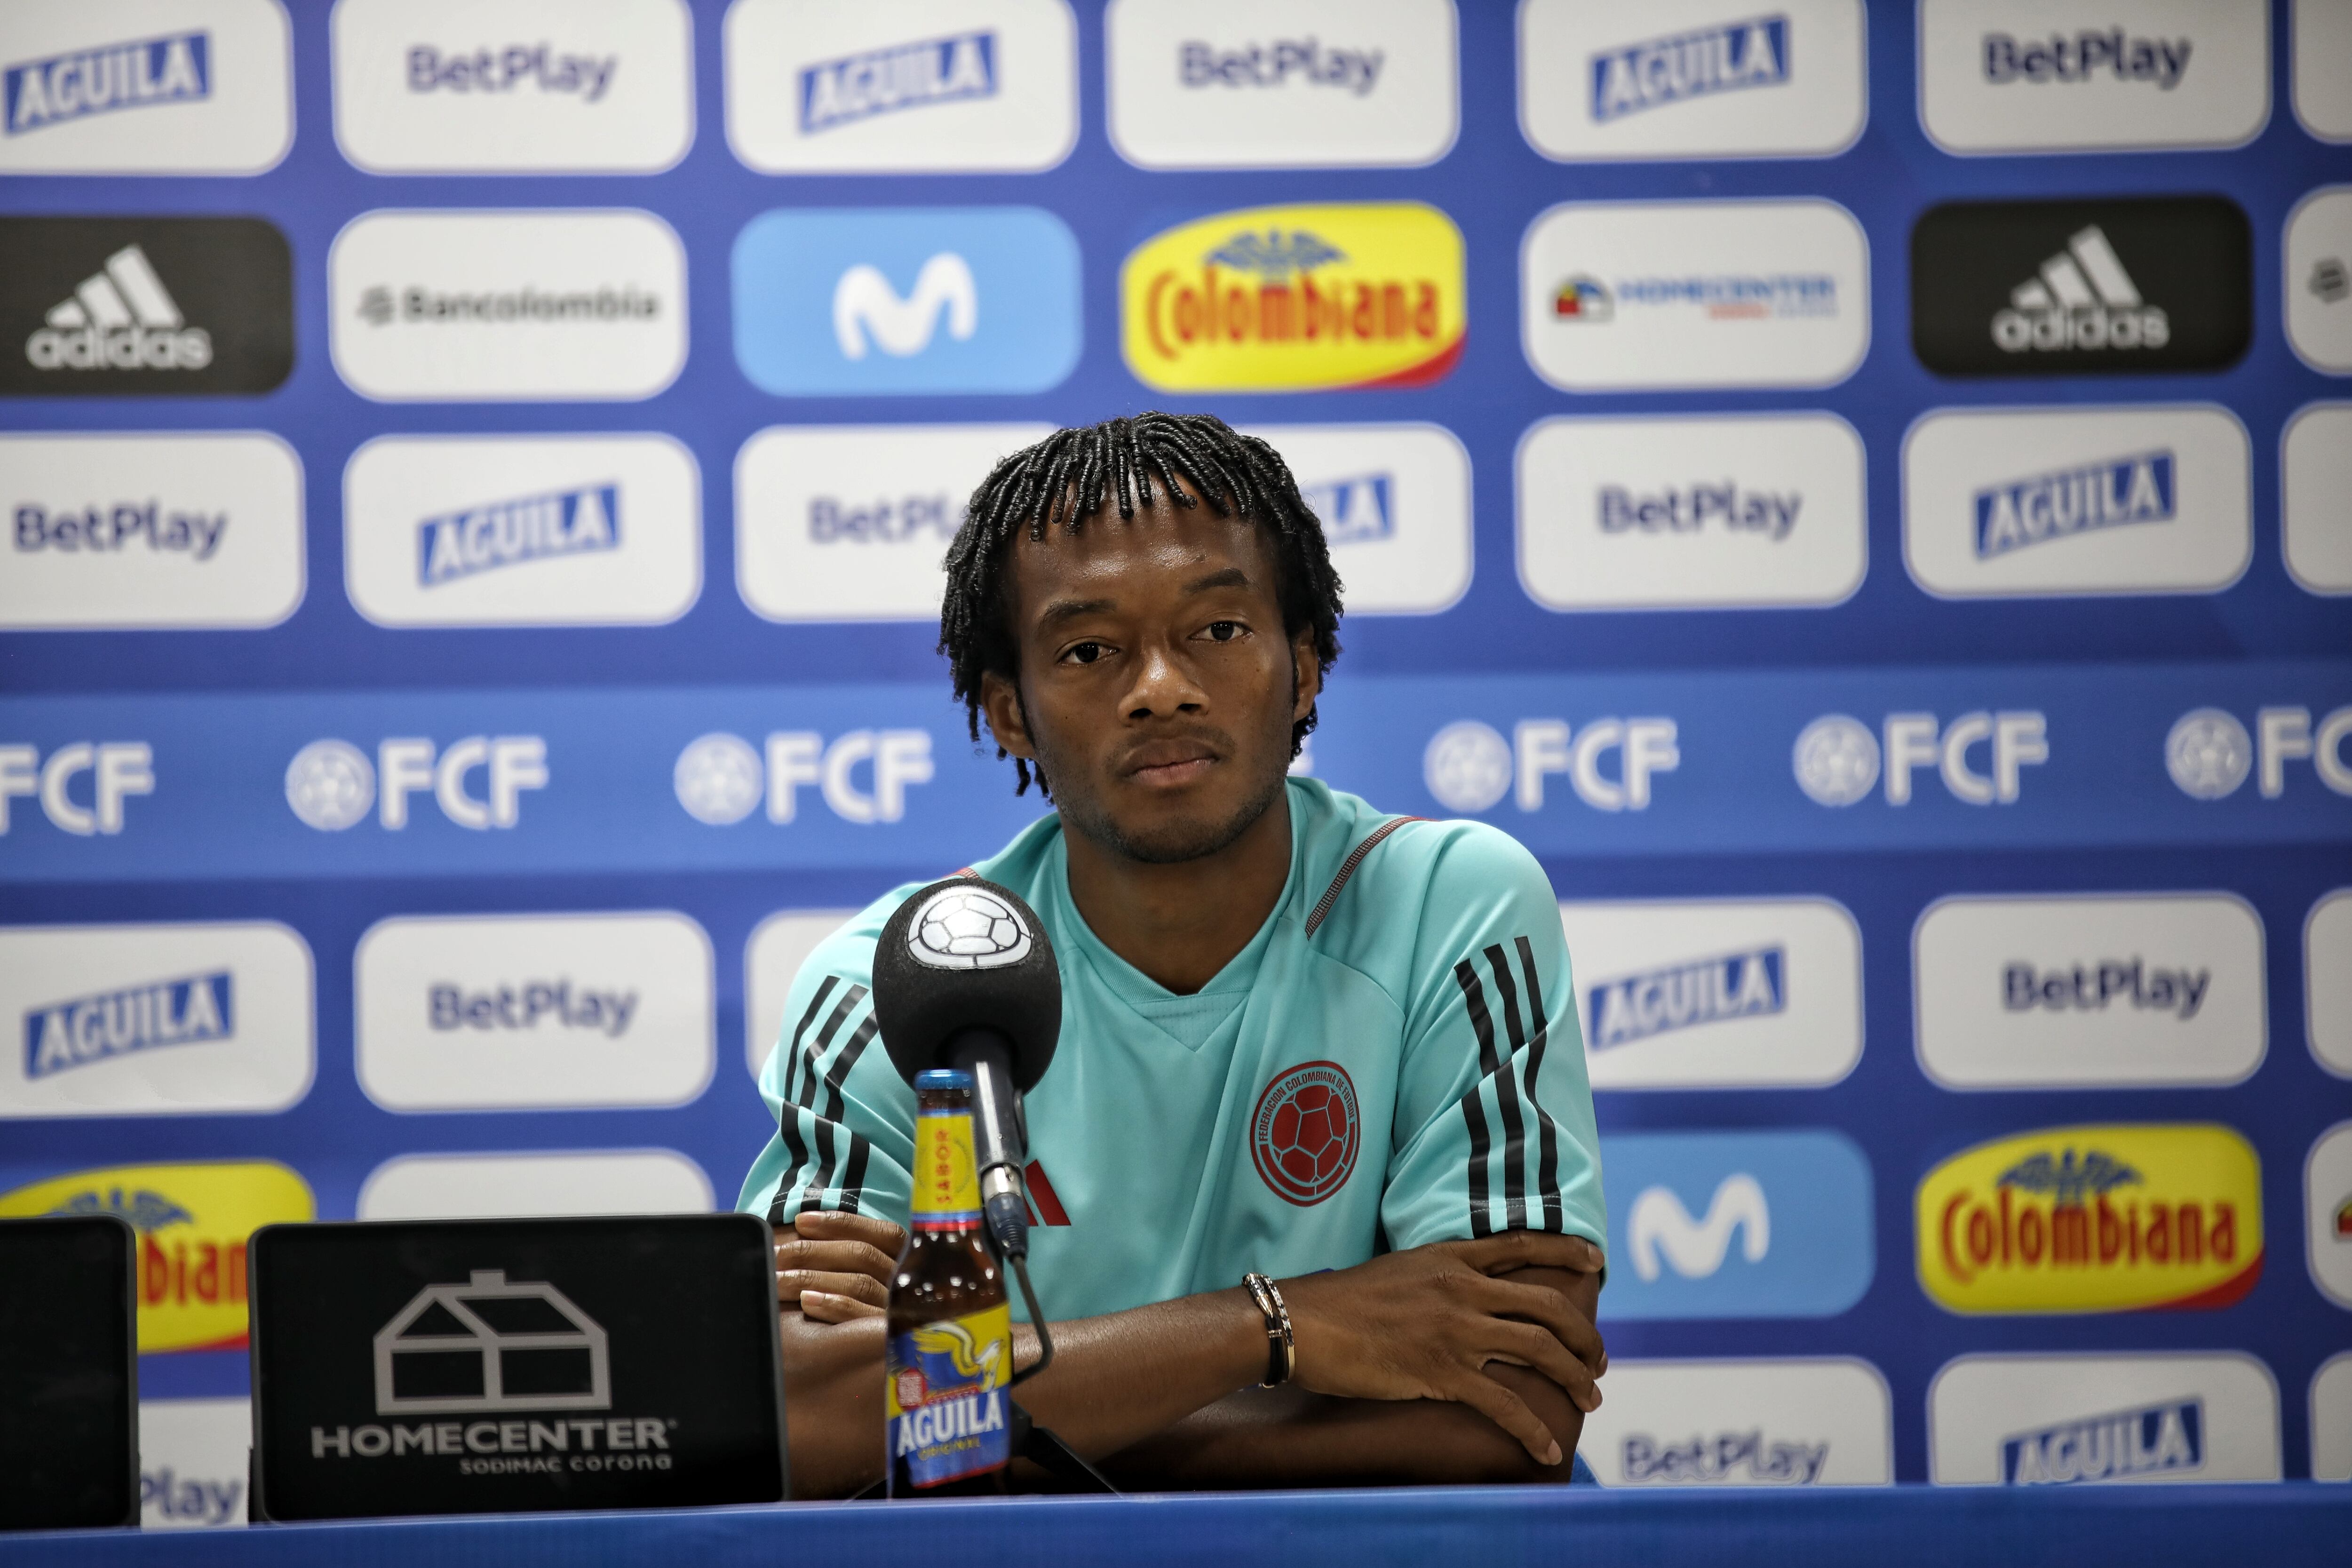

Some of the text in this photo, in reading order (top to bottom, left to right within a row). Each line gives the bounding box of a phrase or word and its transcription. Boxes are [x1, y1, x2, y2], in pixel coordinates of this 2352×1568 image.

[16, 40, 203, 125] AGUILA
[406, 43, 617, 102] BetPlay
[808, 38, 991, 126] AGUILA
[1177, 38, 1385, 97] BetPlay
[1599, 24, 1782, 117] AGUILA
[1983, 27, 2193, 92] BetPlay
[403, 286, 660, 325] Bancolombia
[1145, 265, 1441, 363] Colombiana
[1617, 273, 1836, 305] HOMECENTER
[25, 326, 214, 372] adidas
[1991, 306, 2171, 353] adidas
[13, 498, 228, 563] BetPlay
[427, 488, 615, 582] AGUILA
[808, 491, 964, 545] BetPl
[1596, 480, 1803, 542] BetPlay
[1986, 459, 2168, 557] AGUILA
[378, 735, 549, 833] FCF
[764, 729, 936, 828] FCF
[1514, 714, 1681, 814] FCF
[1884, 711, 2050, 808] FCF
[2257, 706, 2352, 798] FC
[0, 741, 156, 836] FCF
[428, 977, 637, 1037] BetPlay
[1599, 955, 1780, 1049] AGUILA
[2002, 956, 2210, 1021] BetPlay
[31, 977, 228, 1075] AGUILA
[1259, 1071, 1355, 1142] FEDERACION COLOMBIANA DE FUTBOL
[1941, 1181, 2238, 1286] Colombiana
[311, 1420, 670, 1458] HOMECENTER
[896, 1389, 1004, 1457] AGUILA
[1621, 1428, 1829, 1484] BetPlay
[460, 1454, 672, 1475] SODIMAC corona
